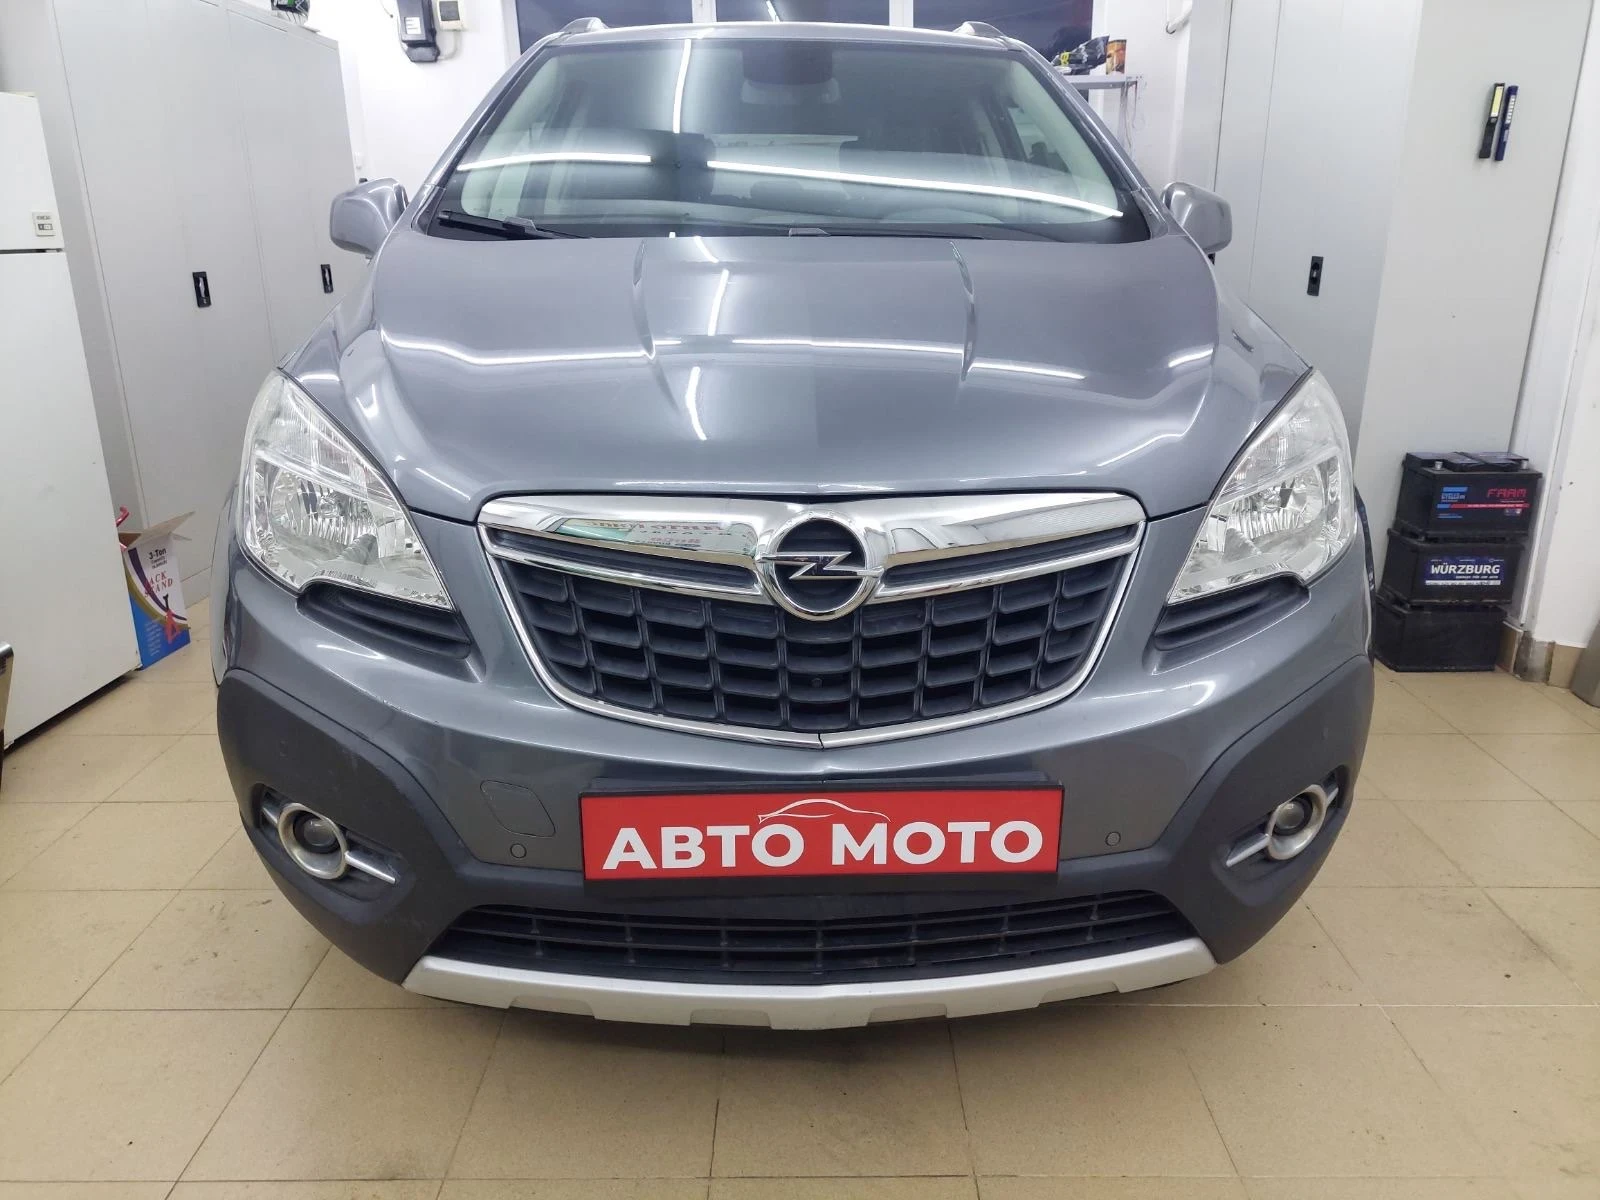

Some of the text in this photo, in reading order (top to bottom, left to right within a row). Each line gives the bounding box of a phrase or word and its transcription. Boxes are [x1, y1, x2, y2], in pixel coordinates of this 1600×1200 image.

[149, 548, 167, 560] 3-Ton
[1431, 562, 1500, 574] WÜRZBURG
[602, 820, 1043, 869] АВТО МОТО
